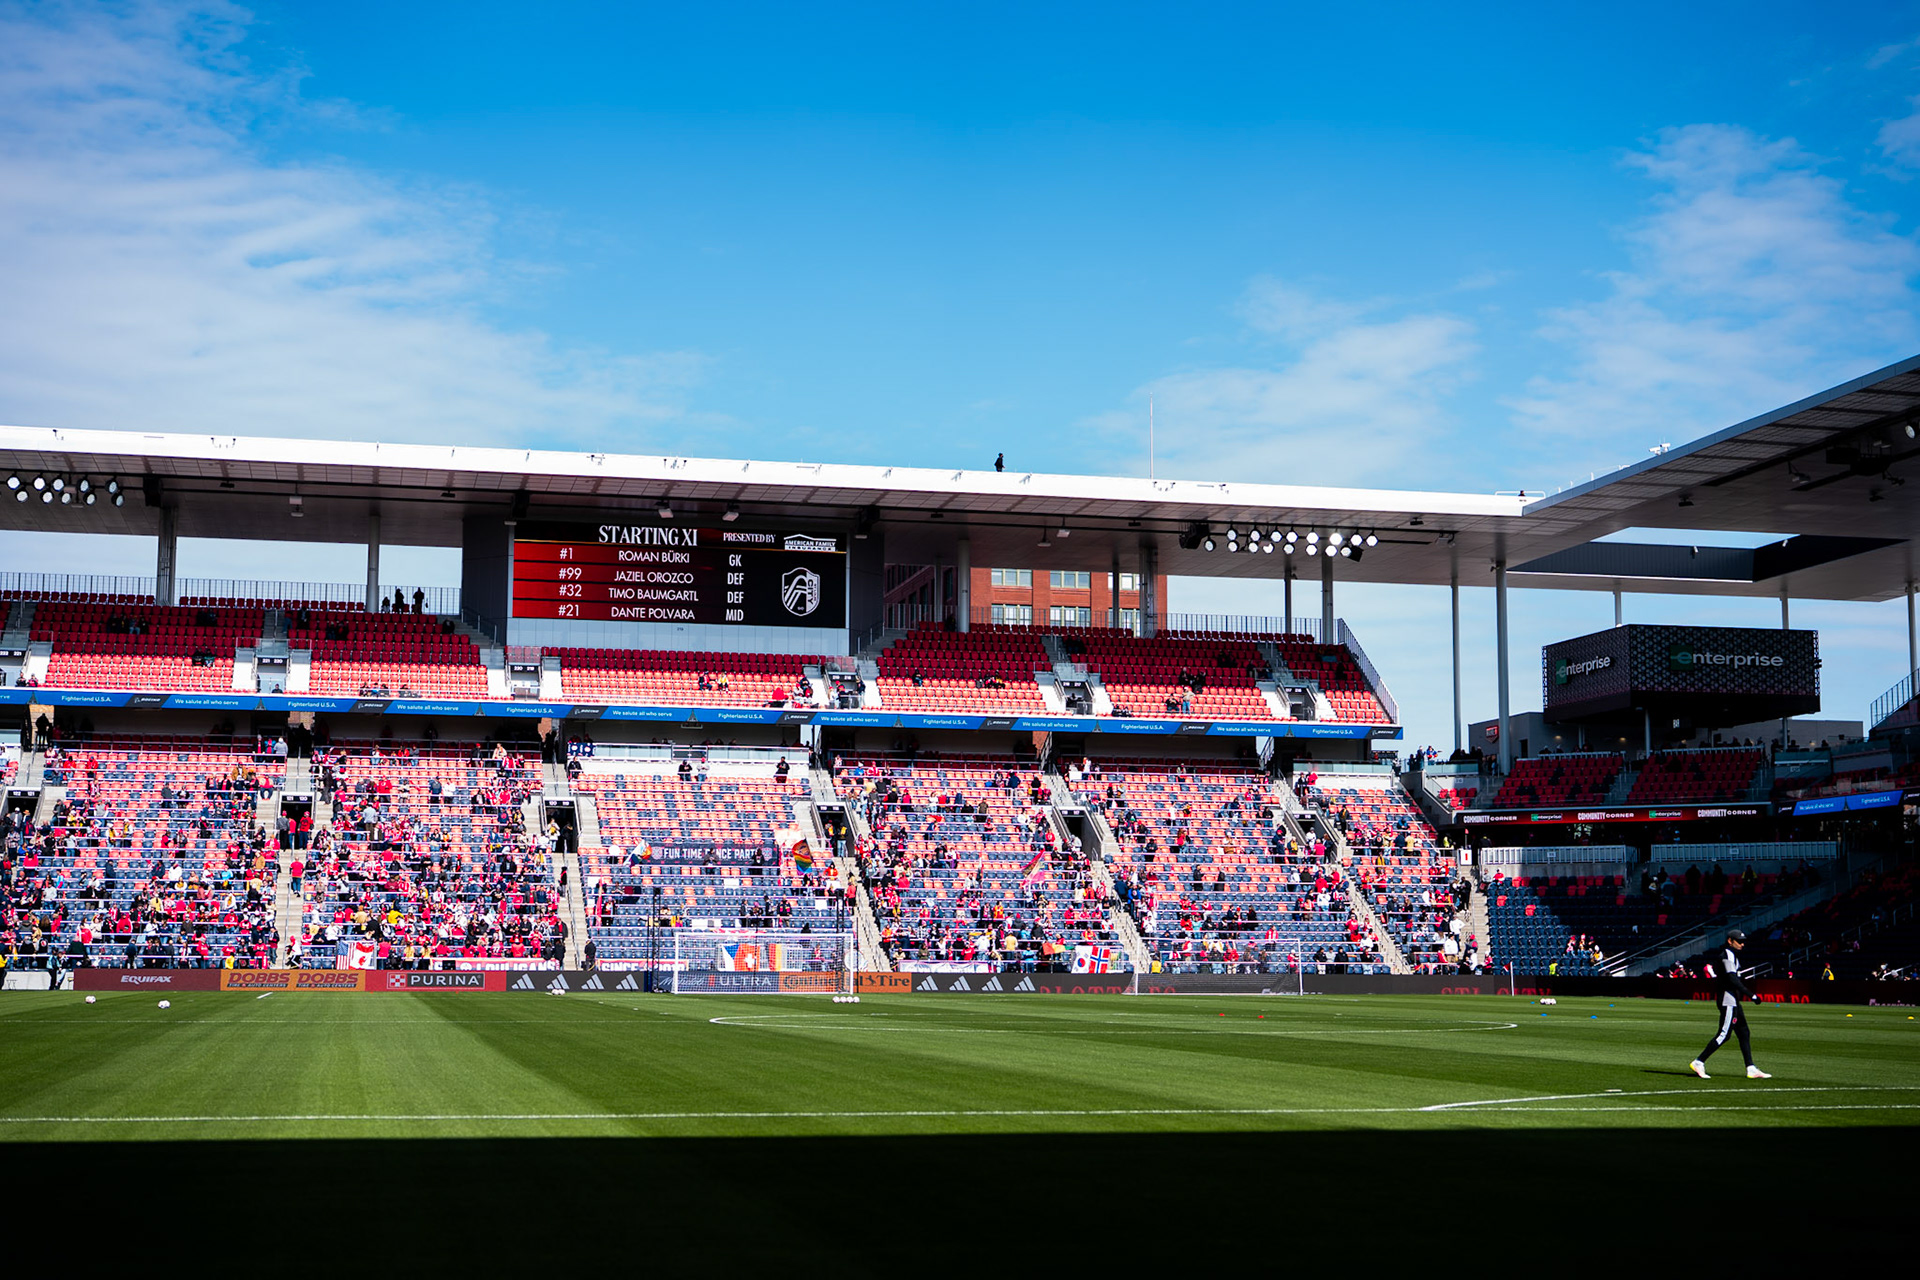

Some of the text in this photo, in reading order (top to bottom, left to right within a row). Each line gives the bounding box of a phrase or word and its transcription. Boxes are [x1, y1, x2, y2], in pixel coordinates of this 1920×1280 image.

[599, 526, 698, 546] STARTING XI
[723, 532, 776, 543] PRESENTED BY
[560, 548, 690, 563] #1 ROMAN BÜRKI
[729, 554, 742, 567] GK
[559, 568, 694, 584] #99 JAZIEL OROZCO
[727, 572, 744, 585] DEF
[559, 584, 699, 601] #32 TIMO BAUMGARTL
[727, 591, 744, 604] DEF
[558, 604, 695, 620] #21 DANTE POLVARA
[726, 609, 744, 622] MID
[1674, 651, 1784, 669] enterprise
[1558, 656, 1610, 678] enterprise
[1464, 815, 1490, 823] COMMUNITY
[1578, 812, 1606, 820] COMMUNITY
[1698, 809, 1726, 817] COMMUNITY
[664, 848, 680, 859] FUN
[683, 848, 702, 859] TIME
[705, 848, 732, 859] DNCE
[121, 975, 172, 984] EQUIFAX
[228, 972, 290, 984] DOBBS
[297, 973, 359, 984] DOBBS
[411, 976, 480, 985] PURINA
[720, 976, 772, 986] ULTRA
[876, 975, 910, 986] Tire
